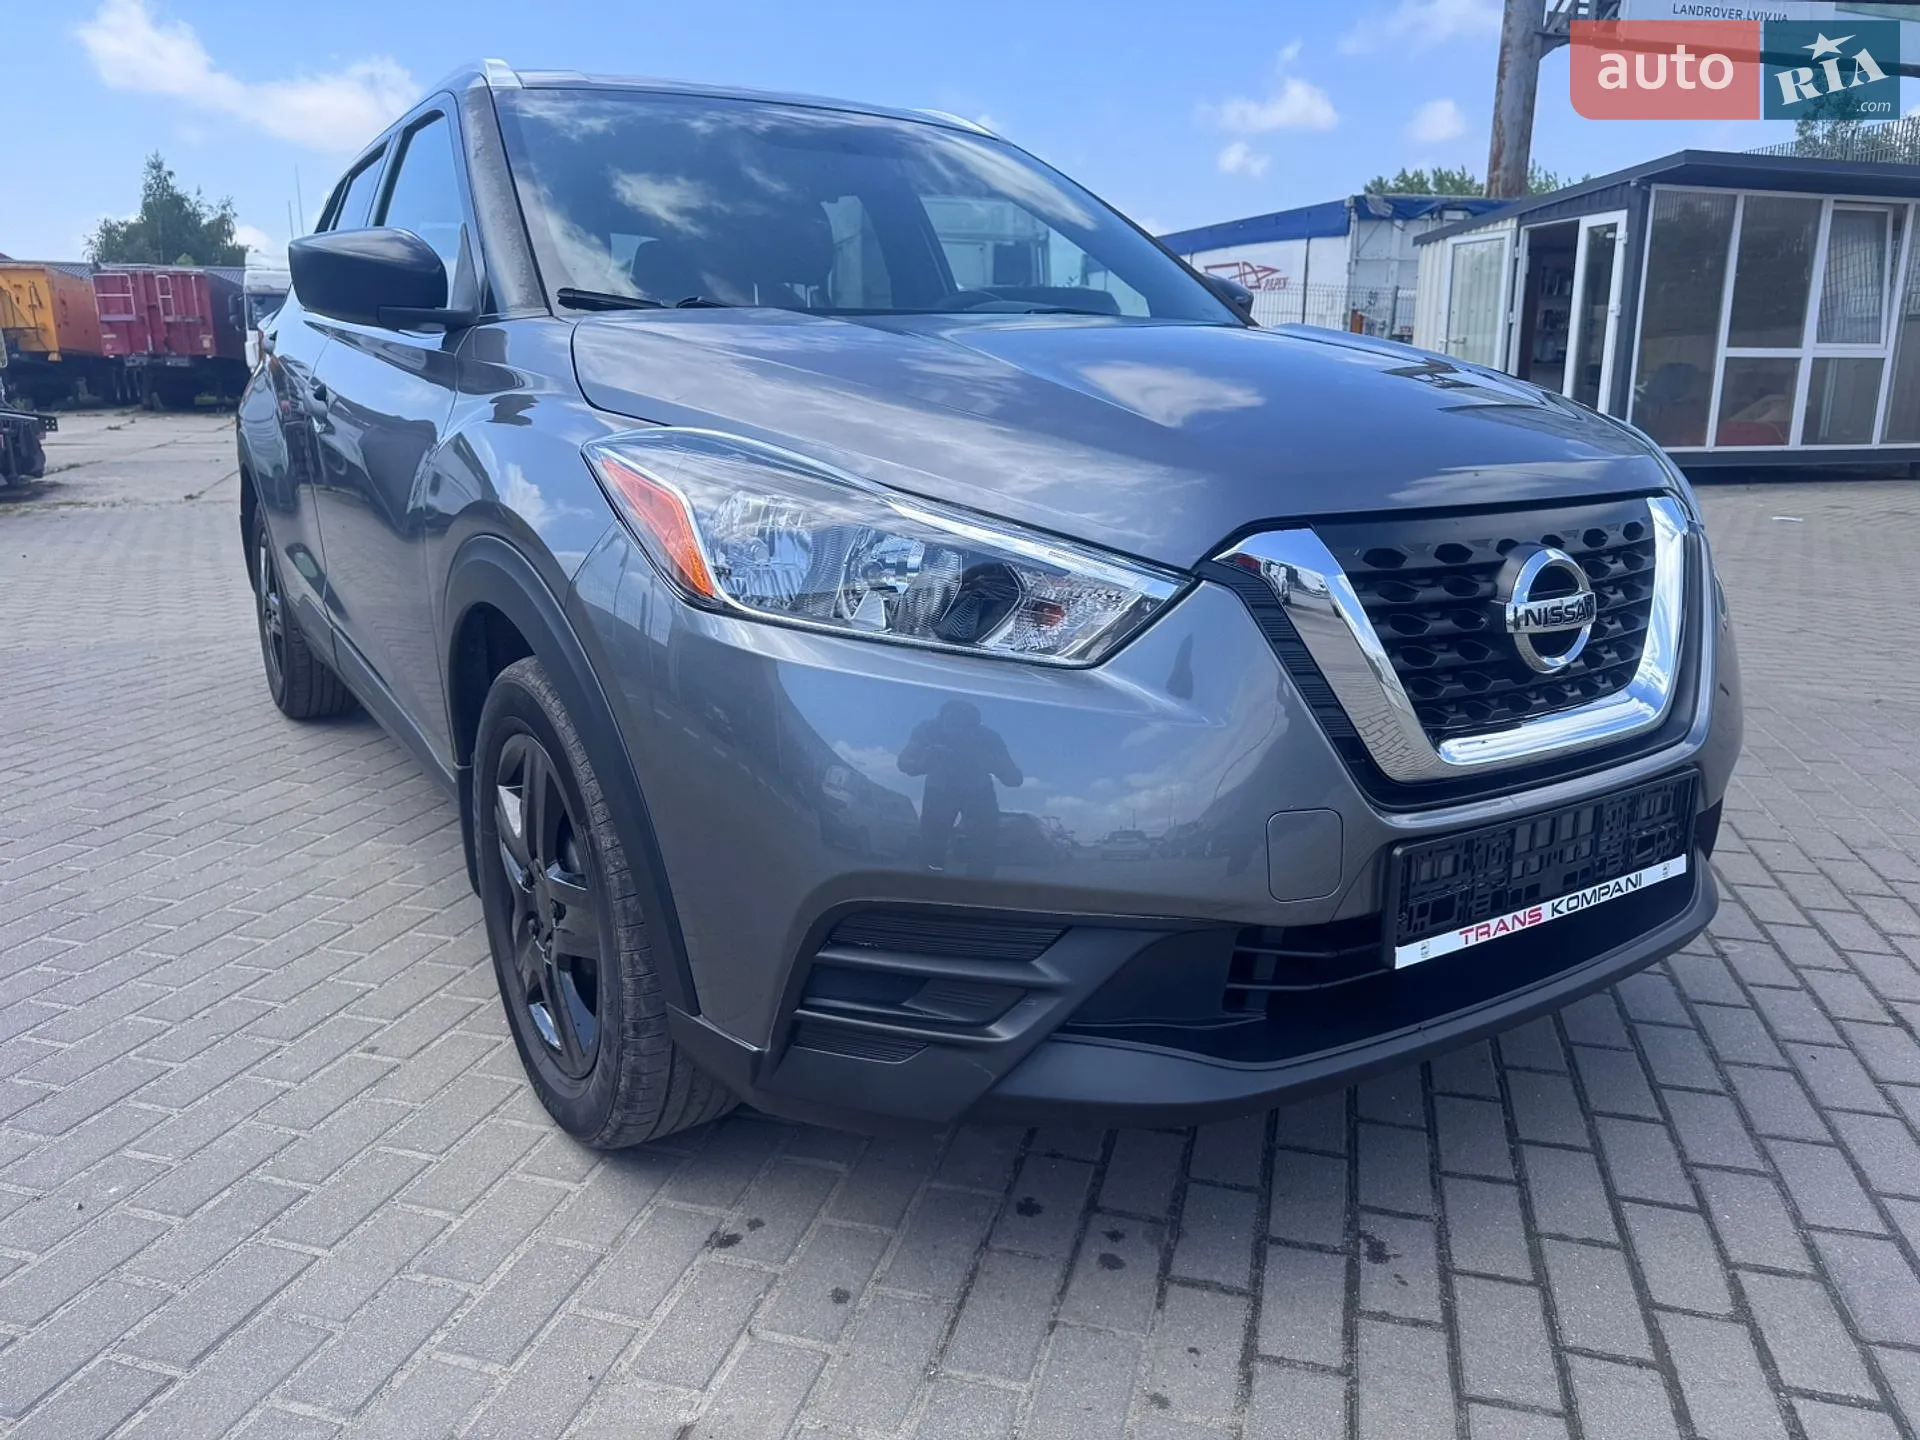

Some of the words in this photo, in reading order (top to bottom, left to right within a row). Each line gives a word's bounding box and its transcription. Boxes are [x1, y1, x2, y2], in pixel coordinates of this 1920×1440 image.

[1672, 4, 1788, 23] LANDROVER.LVIV.UA
[1524, 594, 1594, 627] NISSAN
[1459, 906, 1543, 945] TRANS
[1551, 873, 1642, 917] KOMPANI
